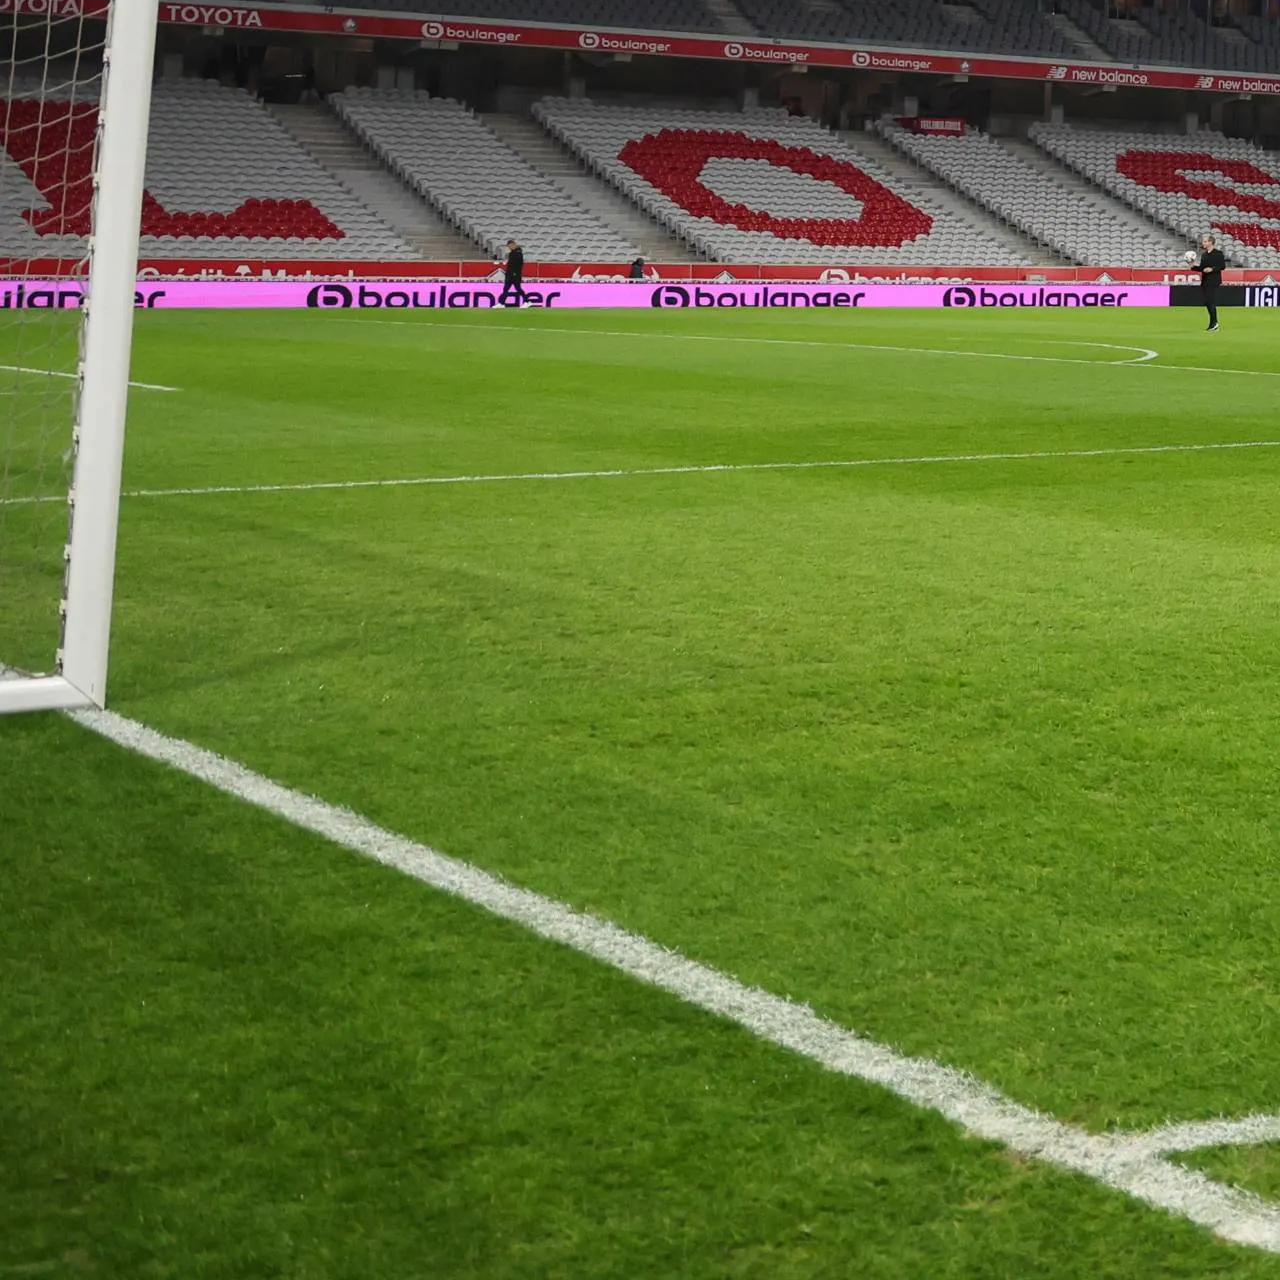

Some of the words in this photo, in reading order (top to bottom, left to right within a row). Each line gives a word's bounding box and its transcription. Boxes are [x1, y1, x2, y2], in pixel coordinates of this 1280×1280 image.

[166, 4, 263, 27] TOYOTA
[446, 27, 521, 43] boulanger
[601, 38, 671, 54] boulanger
[745, 48, 809, 62] boulanger
[871, 56, 933, 71] boulanger
[1072, 69, 1098, 80] new
[1099, 70, 1148, 85] balance
[1218, 78, 1240, 90] new
[694, 287, 865, 308] boulanger
[980, 286, 1128, 308] boulanger
